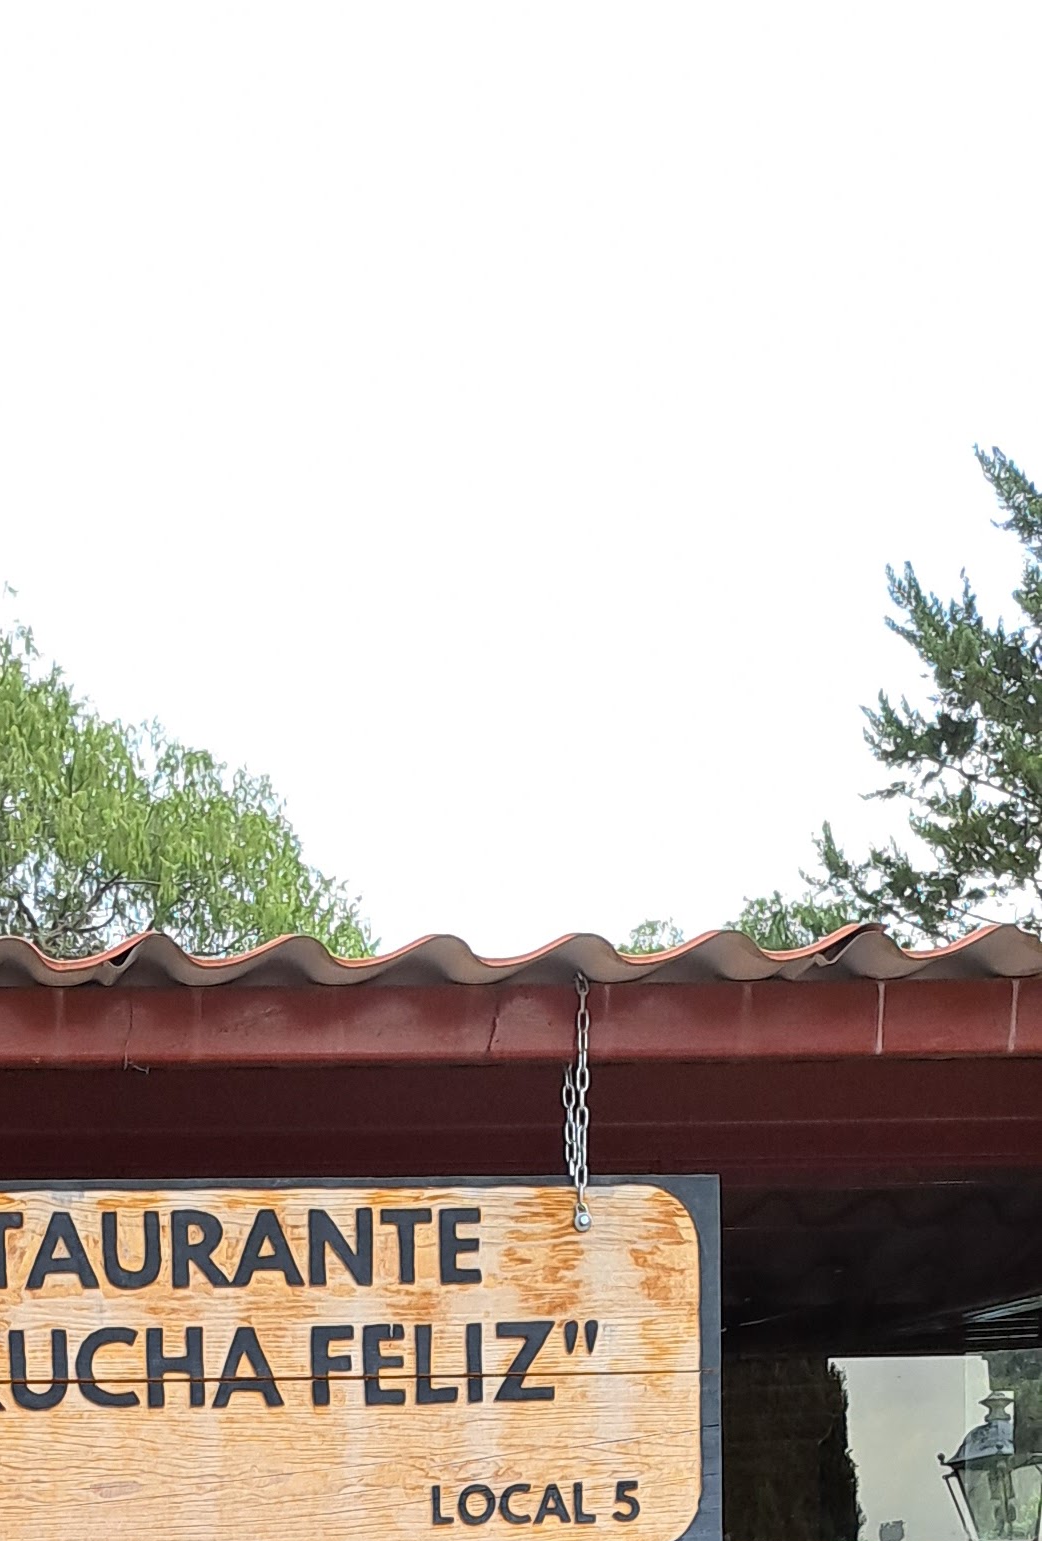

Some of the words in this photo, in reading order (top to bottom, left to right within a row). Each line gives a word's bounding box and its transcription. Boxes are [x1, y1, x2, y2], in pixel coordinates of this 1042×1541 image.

[311, 1319, 598, 1406] FELIZ"
[431, 1481, 596, 1526] LOCAL
[611, 1480, 641, 1523] 5
